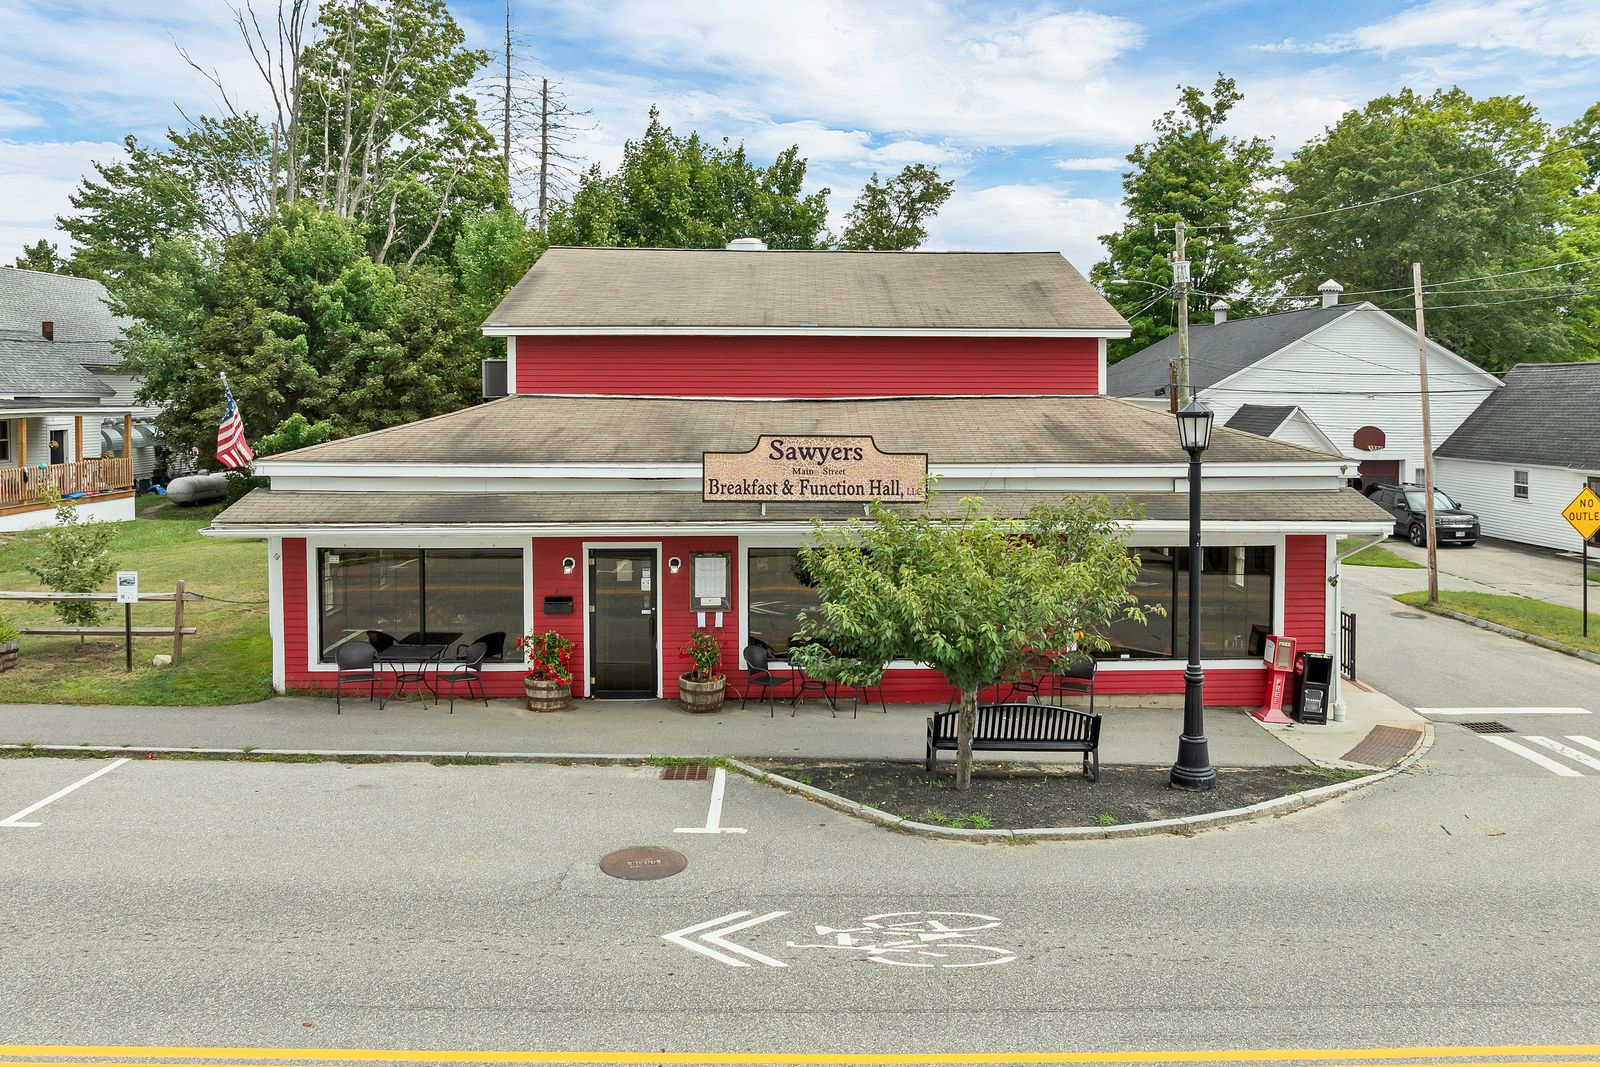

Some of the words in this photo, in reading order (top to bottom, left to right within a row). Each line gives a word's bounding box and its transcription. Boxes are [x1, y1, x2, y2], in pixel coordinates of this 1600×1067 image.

[768, 439, 863, 465] Sawyers
[792, 467, 814, 475] Main
[822, 467, 846, 475] Street
[708, 479, 778, 495] Breakfast
[782, 480, 794, 495] &
[799, 479, 865, 496] Function
[869, 479, 904, 498] Hall,
[906, 487, 923, 496] LLC
[1580, 499, 1594, 508] NO
[1569, 511, 1600, 521] OUTLE
